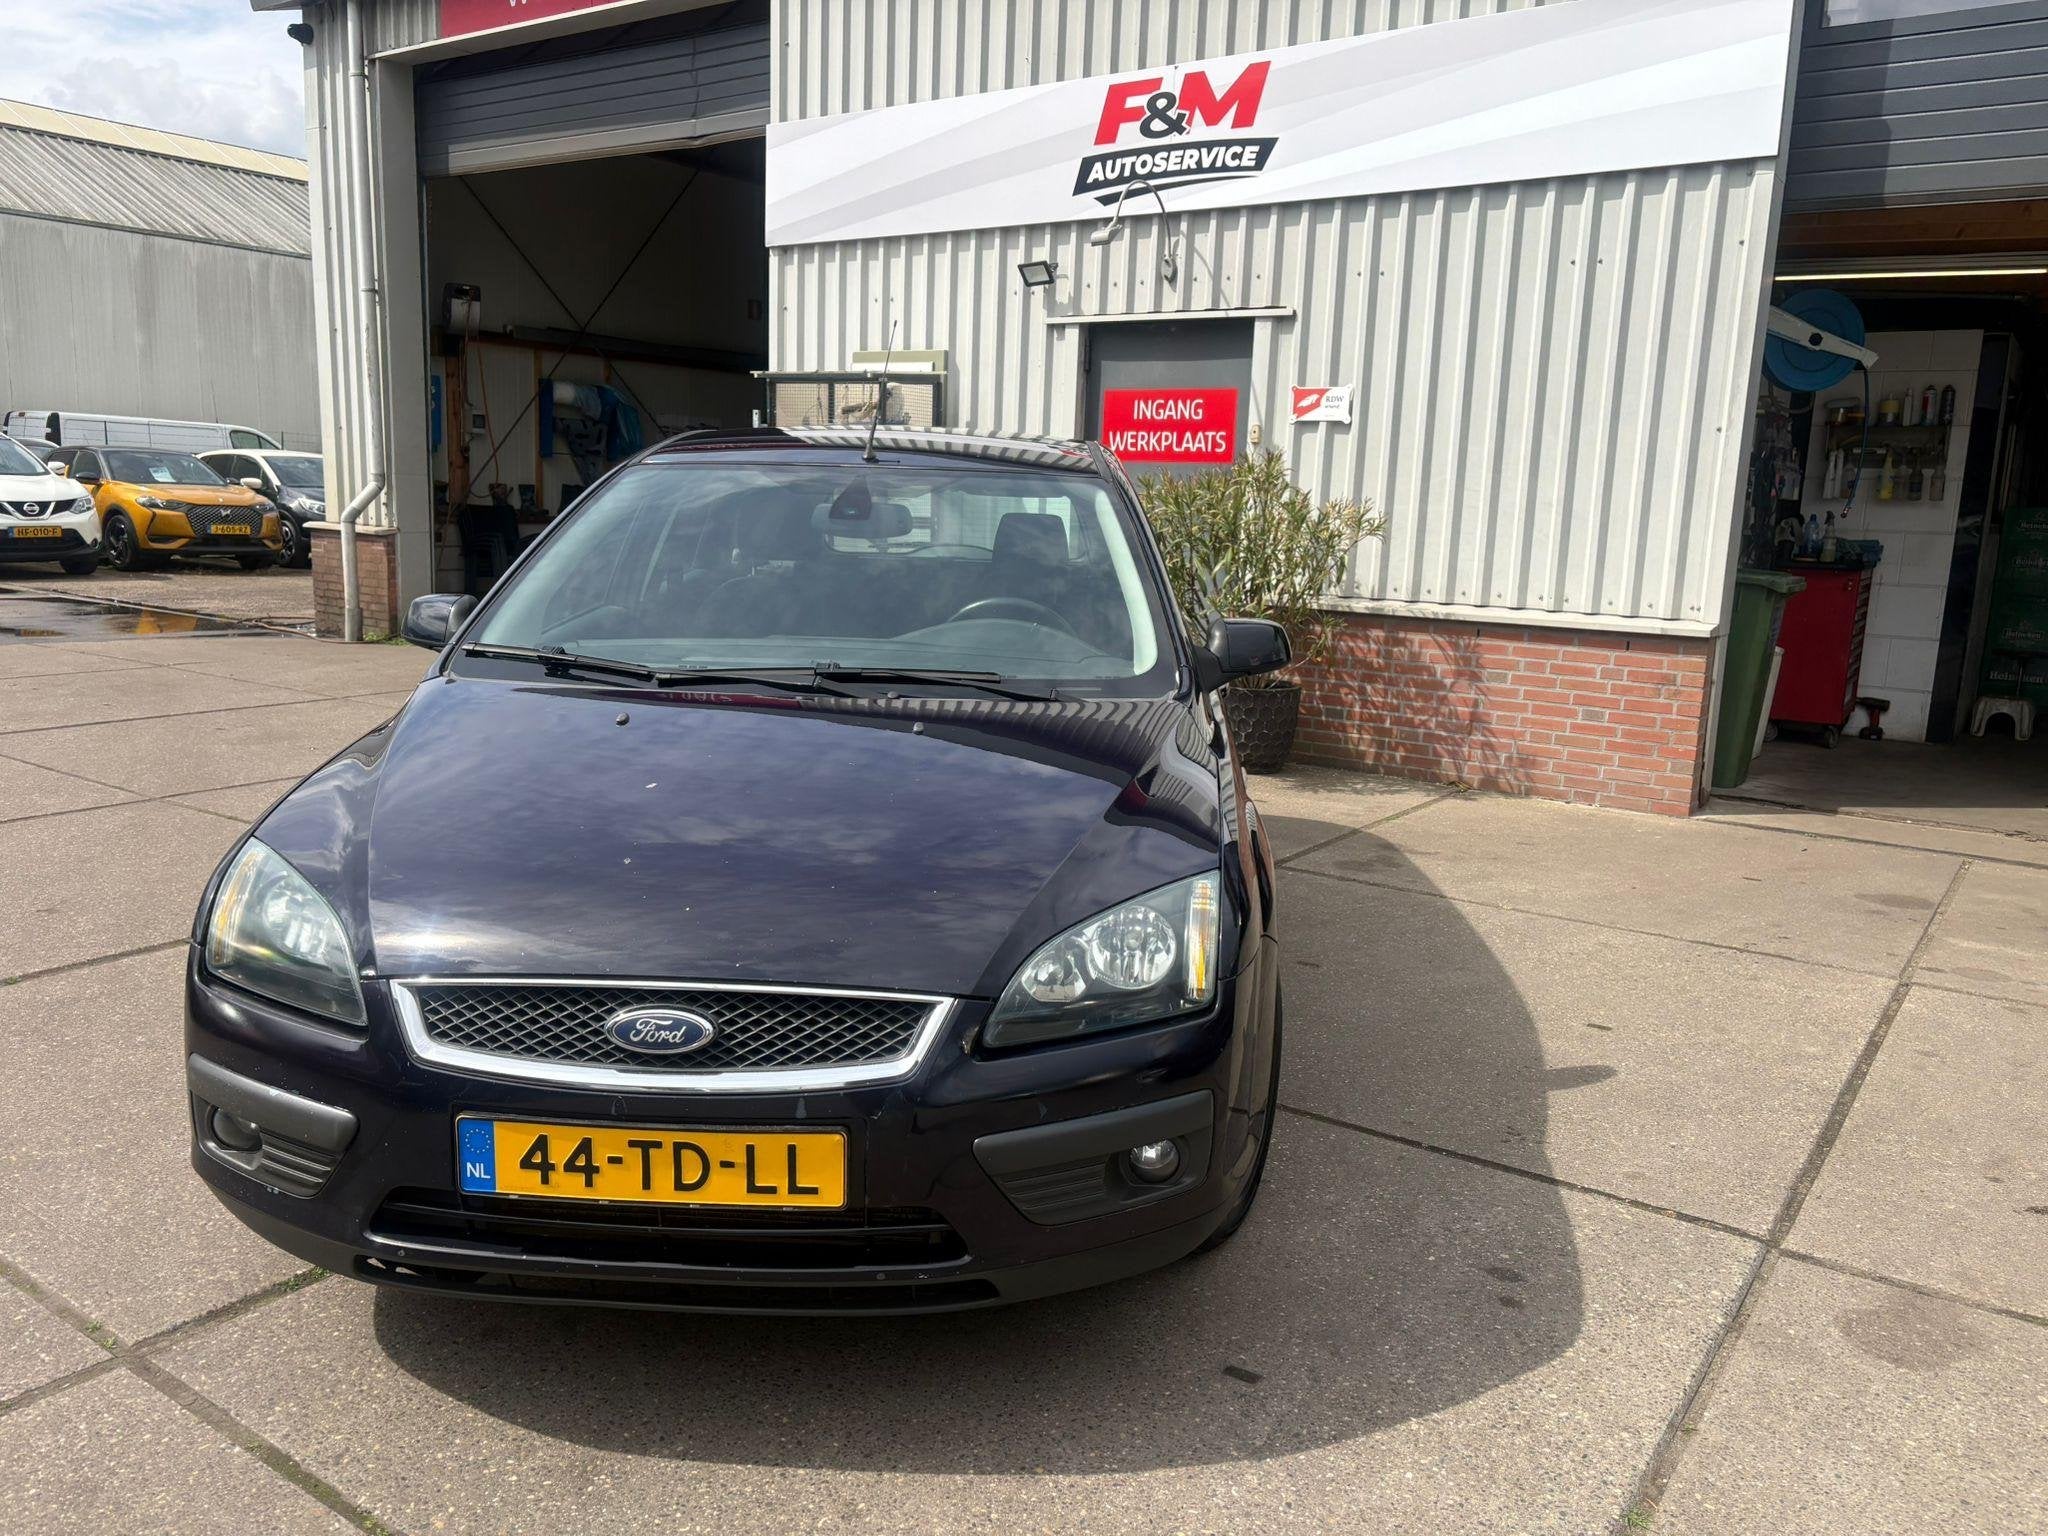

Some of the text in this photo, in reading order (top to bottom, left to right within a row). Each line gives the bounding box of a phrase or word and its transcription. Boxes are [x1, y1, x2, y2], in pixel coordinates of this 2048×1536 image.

[1094, 61, 1271, 145] F&M
[1087, 145, 1260, 183] AUTOSERVICE
[1133, 399, 1204, 420] INGANG
[1109, 431, 1227, 453] WERKPLAATS
[630, 1018, 686, 1043] Ford
[466, 1162, 491, 1179] NL
[519, 1133, 819, 1194] 44-TD-LL
